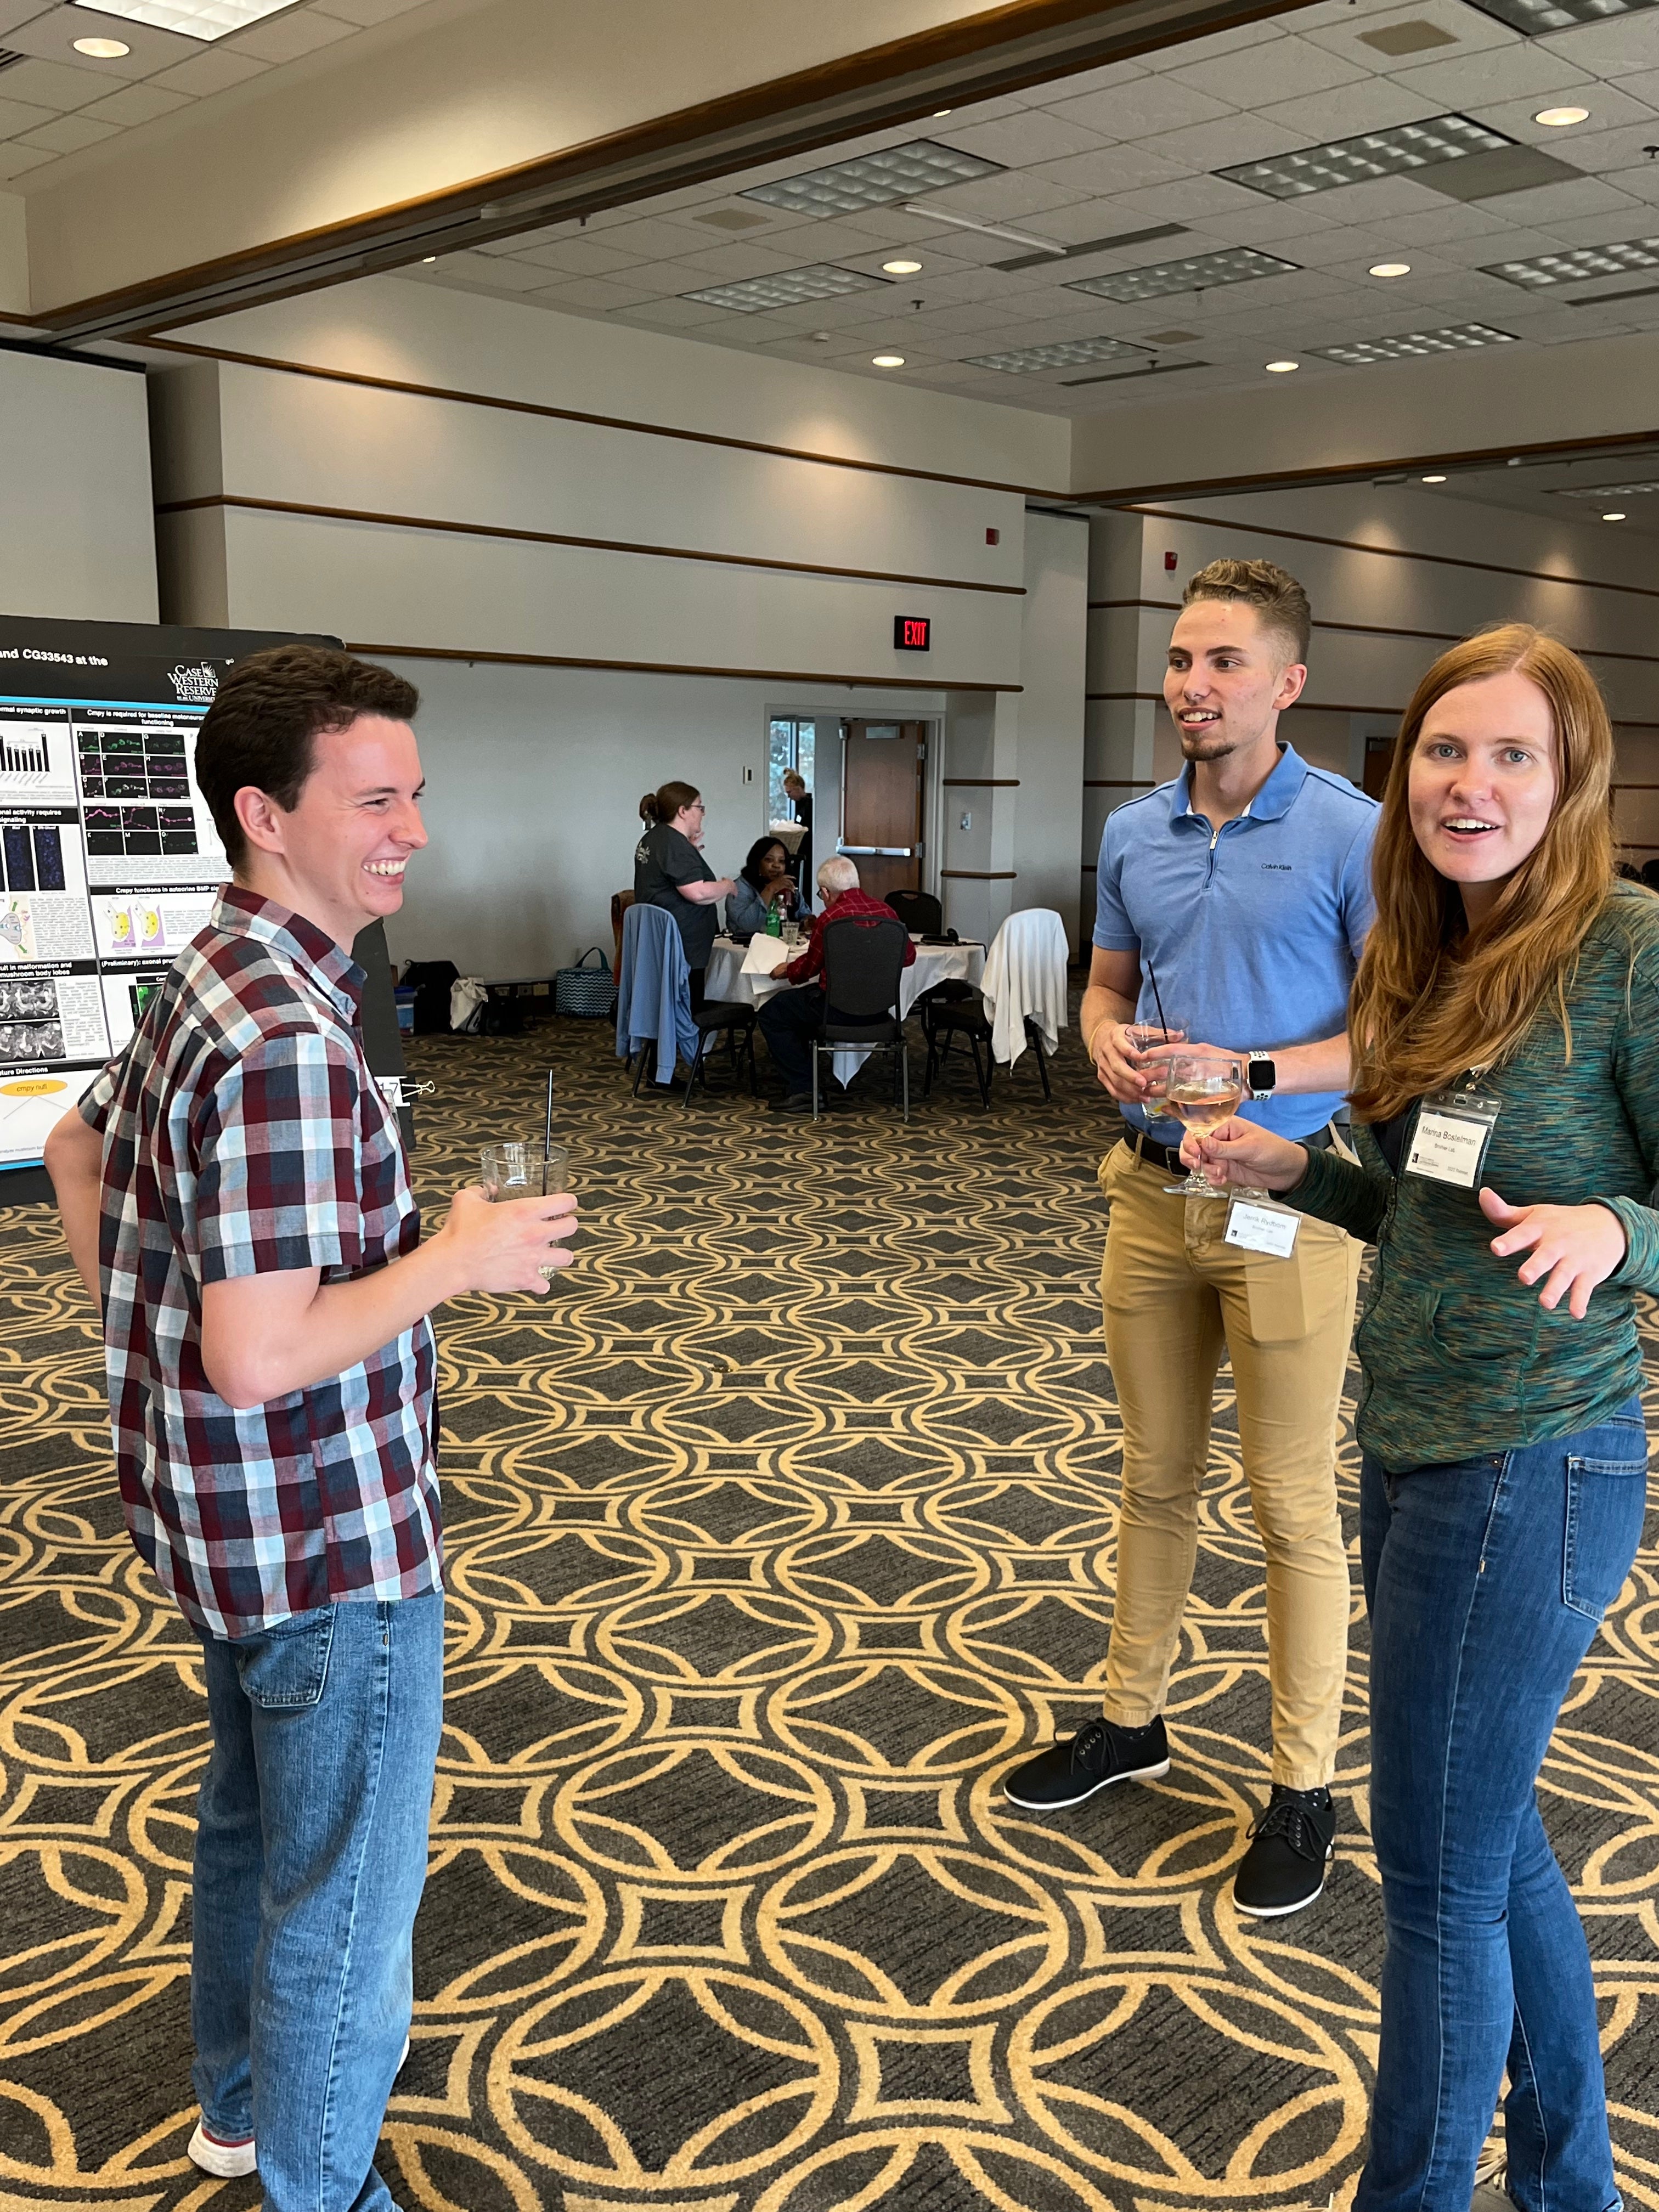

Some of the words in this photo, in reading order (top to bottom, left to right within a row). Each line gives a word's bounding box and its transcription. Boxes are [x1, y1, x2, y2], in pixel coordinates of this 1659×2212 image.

[904, 620, 927, 646] EXIT
[22, 648, 74, 664] CG33543
[75, 656, 88, 665] at
[88, 656, 109, 666] the
[174, 664, 204, 677] CASE
[167, 673, 219, 687] WESTERN
[175, 682, 217, 696] RESERVE
[142, 719, 174, 727] functioning
[380, 1082, 398, 1096] 17
[1421, 1126, 1441, 1138] Marina
[1442, 1131, 1476, 1146] Bostelman
